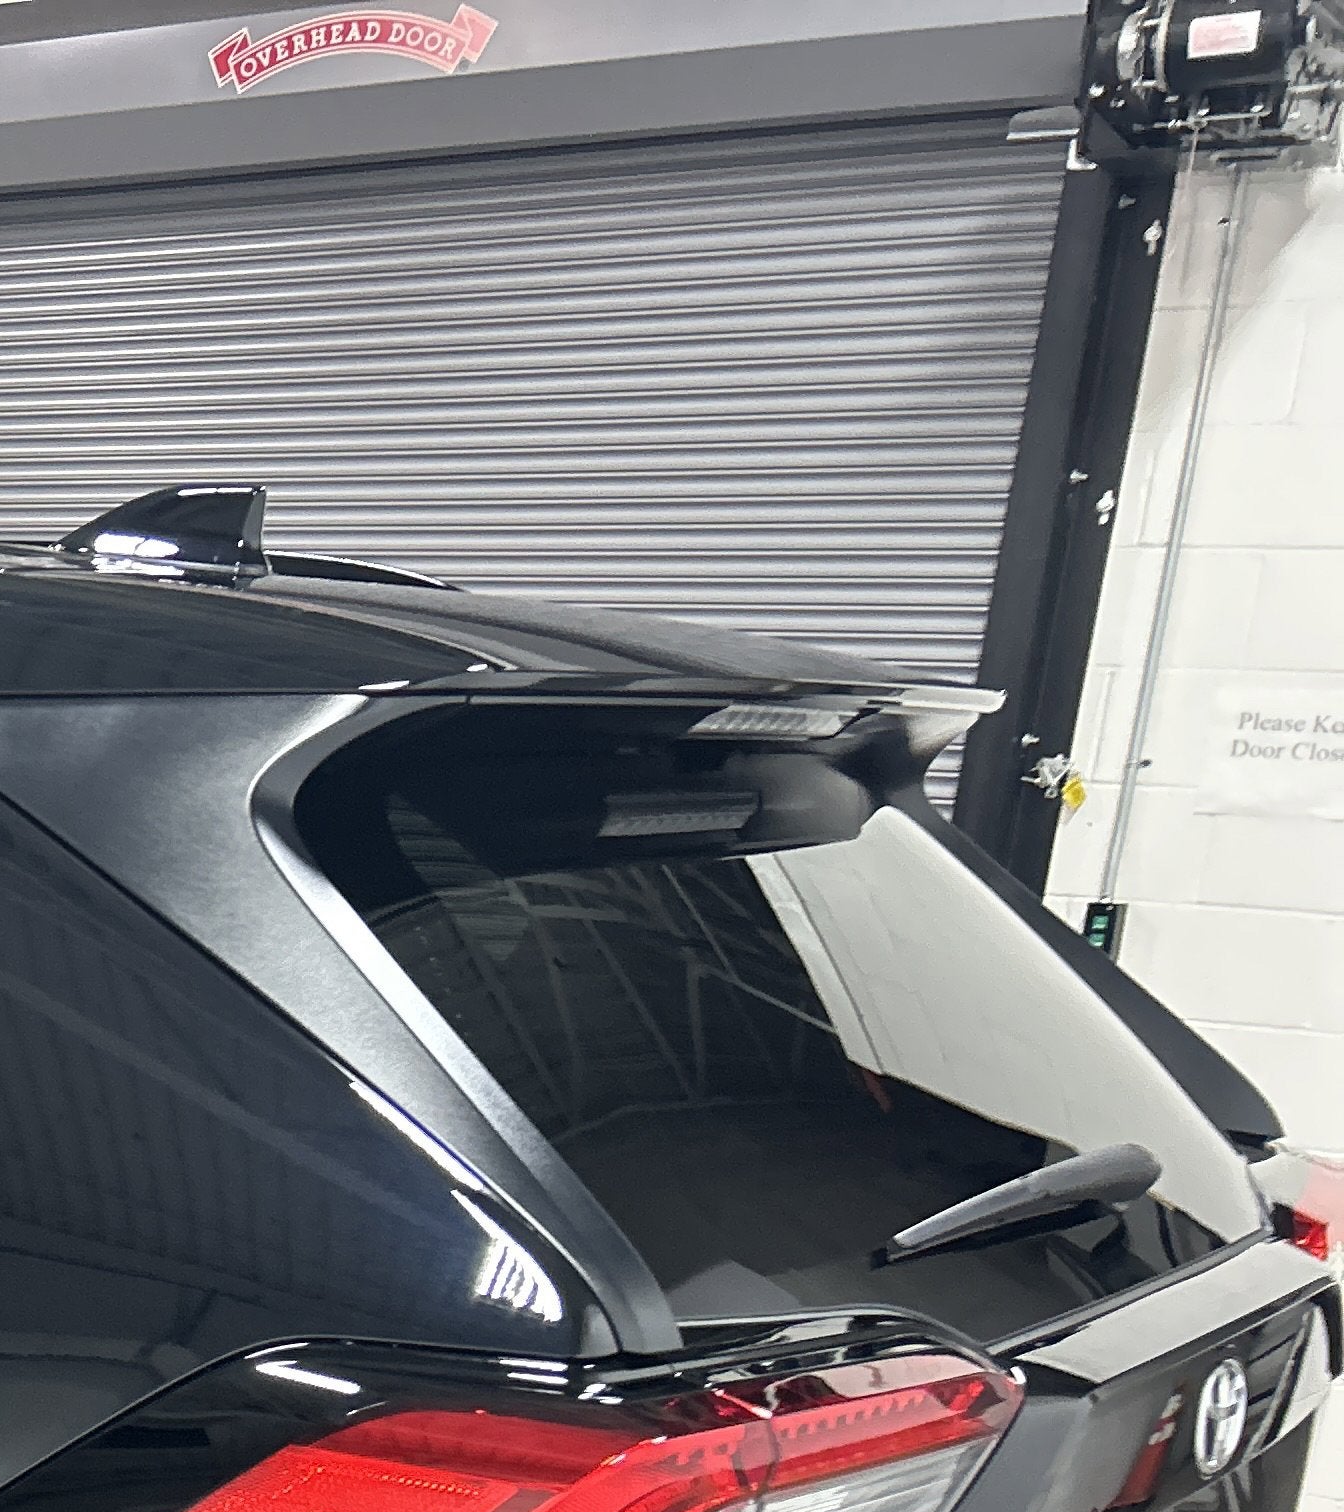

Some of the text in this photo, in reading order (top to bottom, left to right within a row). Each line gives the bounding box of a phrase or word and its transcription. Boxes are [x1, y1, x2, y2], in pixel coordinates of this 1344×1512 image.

[239, 20, 457, 78] OVERHEAD DOOR
[1237, 711, 1307, 732] Please
[1230, 739, 1286, 760] Door
